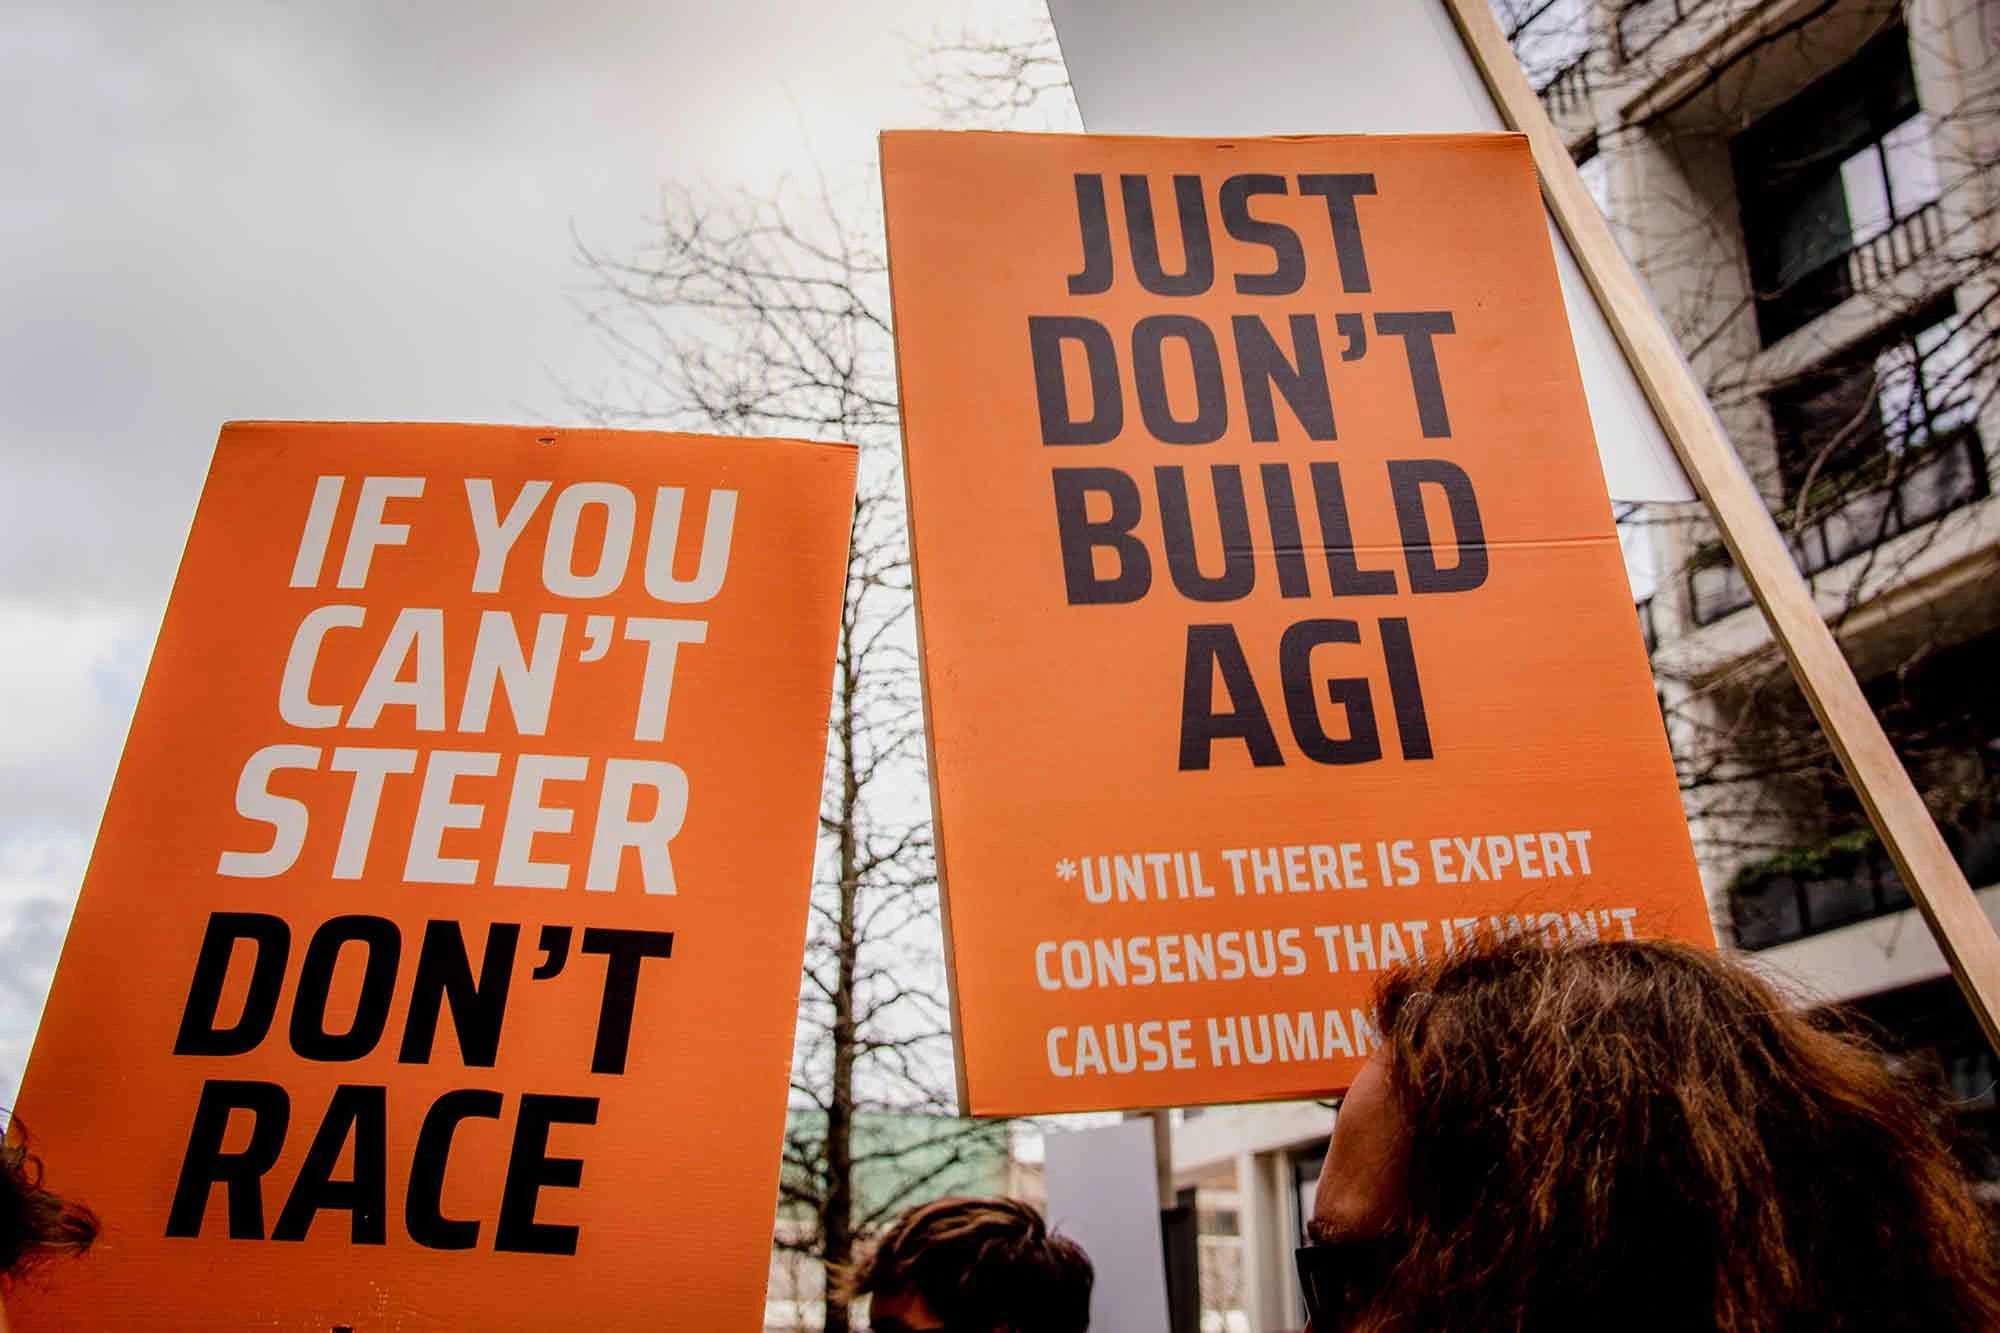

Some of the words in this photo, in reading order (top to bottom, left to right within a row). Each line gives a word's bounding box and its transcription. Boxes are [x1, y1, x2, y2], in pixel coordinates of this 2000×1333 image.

[1067, 173, 1378, 297] JUST
[1028, 311, 1456, 446] DON'T
[289, 475, 427, 589] IF
[464, 478, 738, 603] YOU
[1052, 458, 1489, 606] BUILD
[278, 605, 708, 742] CAN'T
[1178, 616, 1434, 771] AGI
[216, 744, 689, 896] STEER
[1222, 841, 1368, 895] THERE
[1379, 839, 1420, 887] IS
[1428, 830, 1592, 885] EXPERT
[173, 912, 674, 1075] DON'T
[1034, 927, 1306, 990] CONSENSUS
[1314, 920, 1428, 973] THAT
[1441, 917, 1480, 962] IT
[1046, 1019, 1197, 1077] CAUSE
[164, 1079, 600, 1256] RACE
